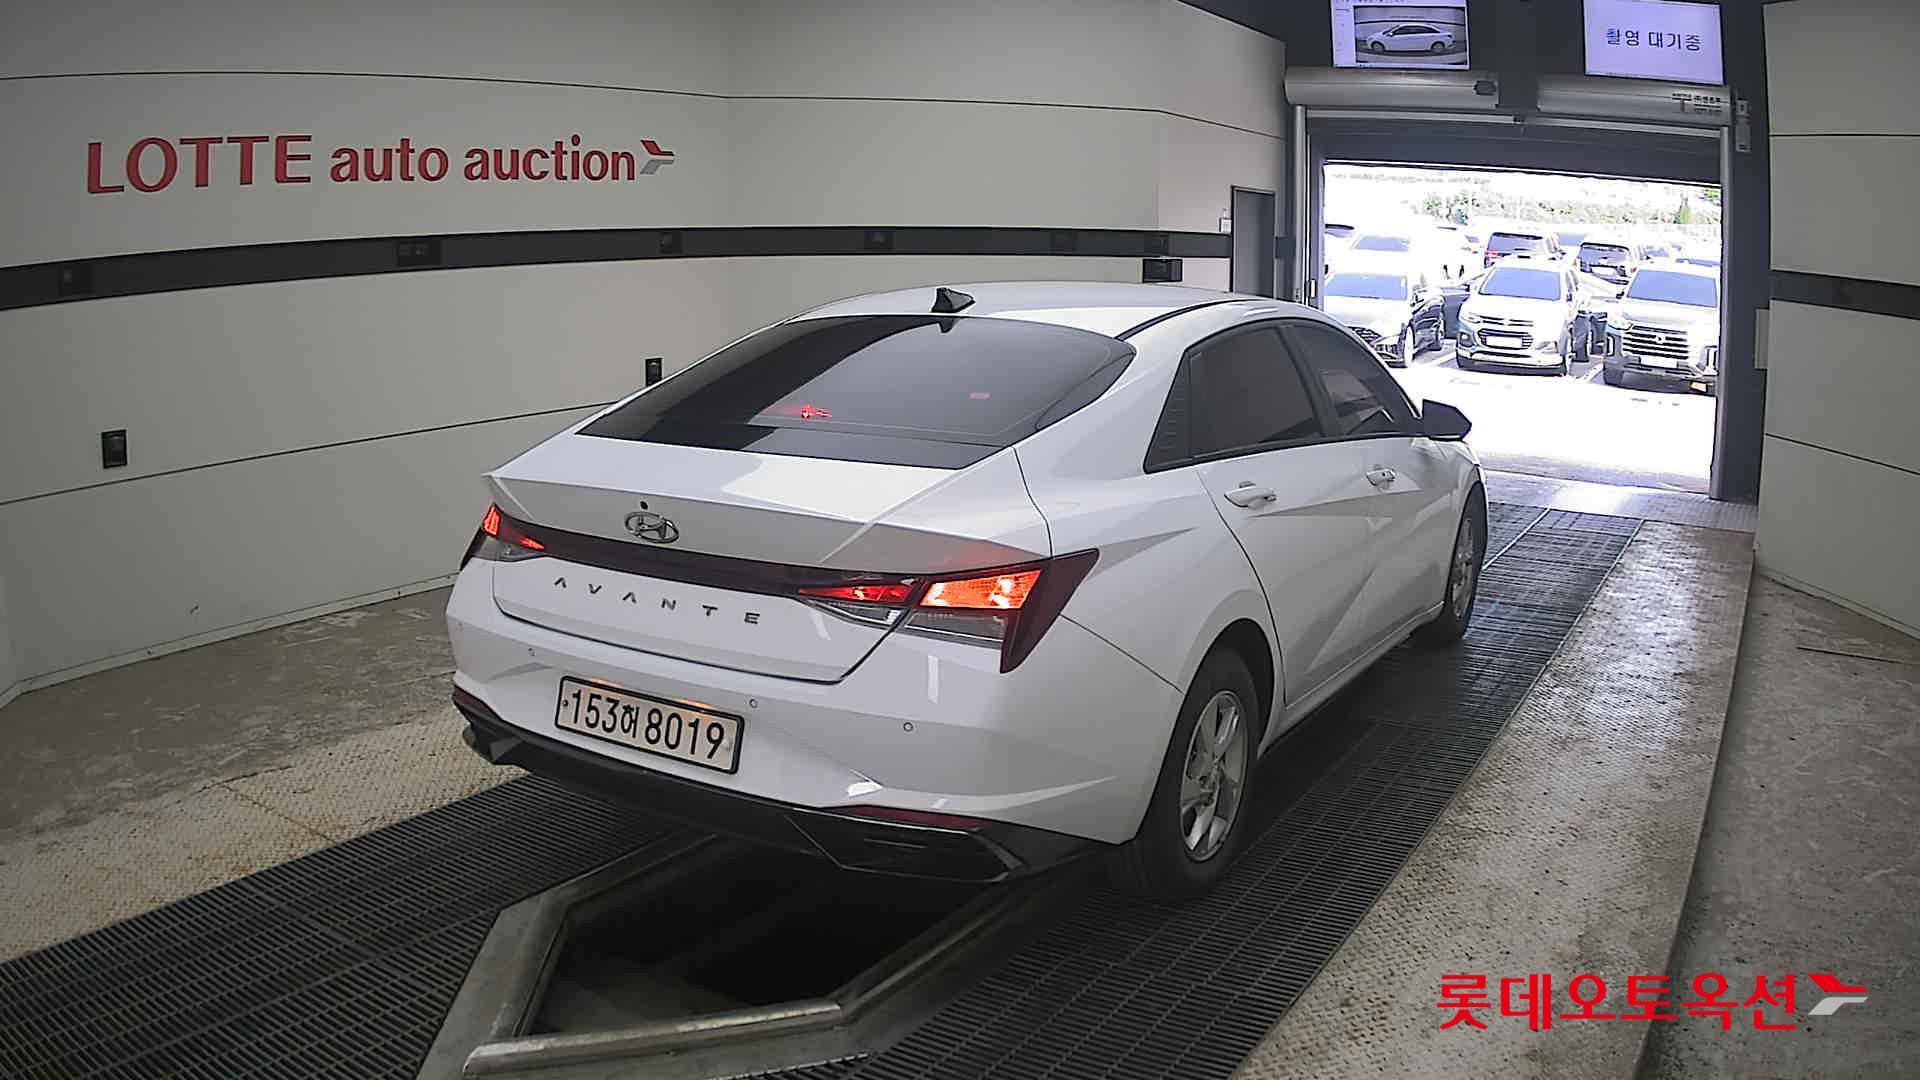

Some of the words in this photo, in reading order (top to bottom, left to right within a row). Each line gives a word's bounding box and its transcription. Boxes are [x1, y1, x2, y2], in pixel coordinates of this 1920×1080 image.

[1648, 31, 1701, 51] 대기중
[87, 135, 312, 193] LOTTE
[330, 138, 449, 181] auto
[464, 134, 635, 181] auction
[554, 577, 761, 624] AVANTE
